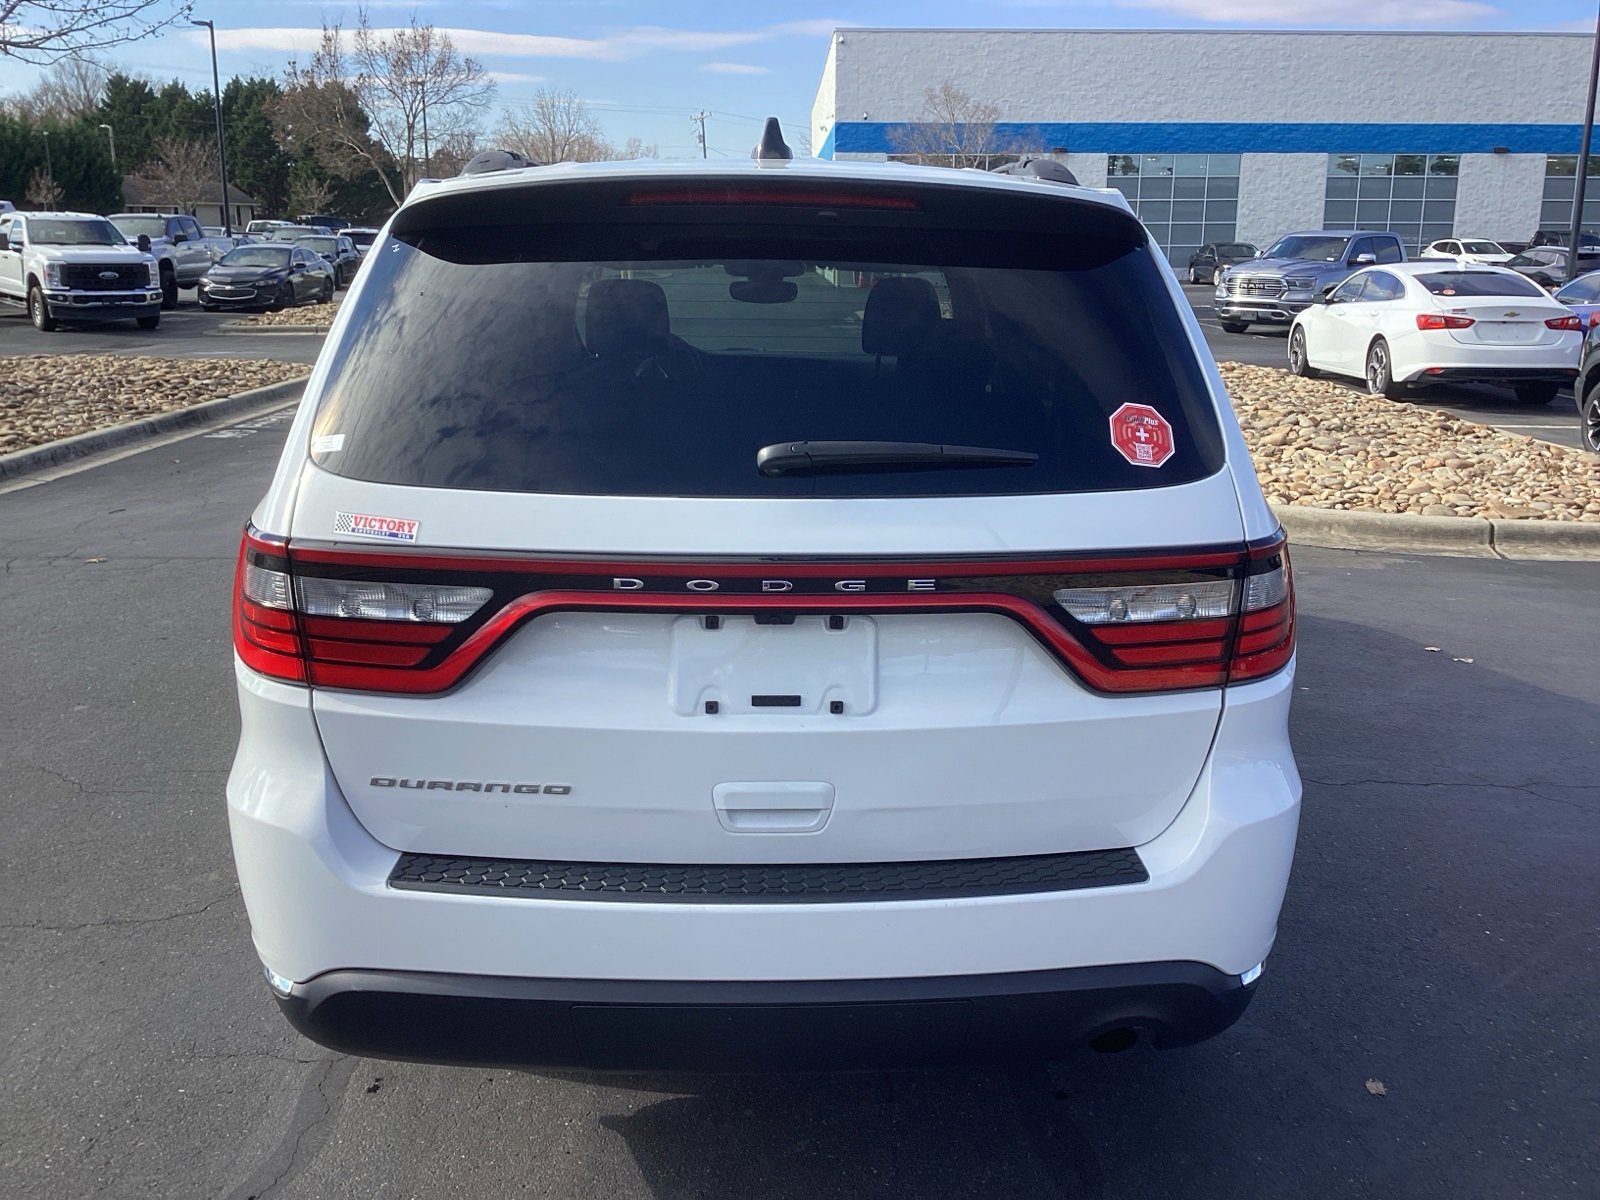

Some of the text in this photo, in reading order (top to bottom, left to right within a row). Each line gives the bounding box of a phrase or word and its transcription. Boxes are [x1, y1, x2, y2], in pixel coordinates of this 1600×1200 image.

[353, 516, 416, 533] VICTORY
[613, 578, 936, 591] DODGE
[370, 777, 572, 795] DURANGO
